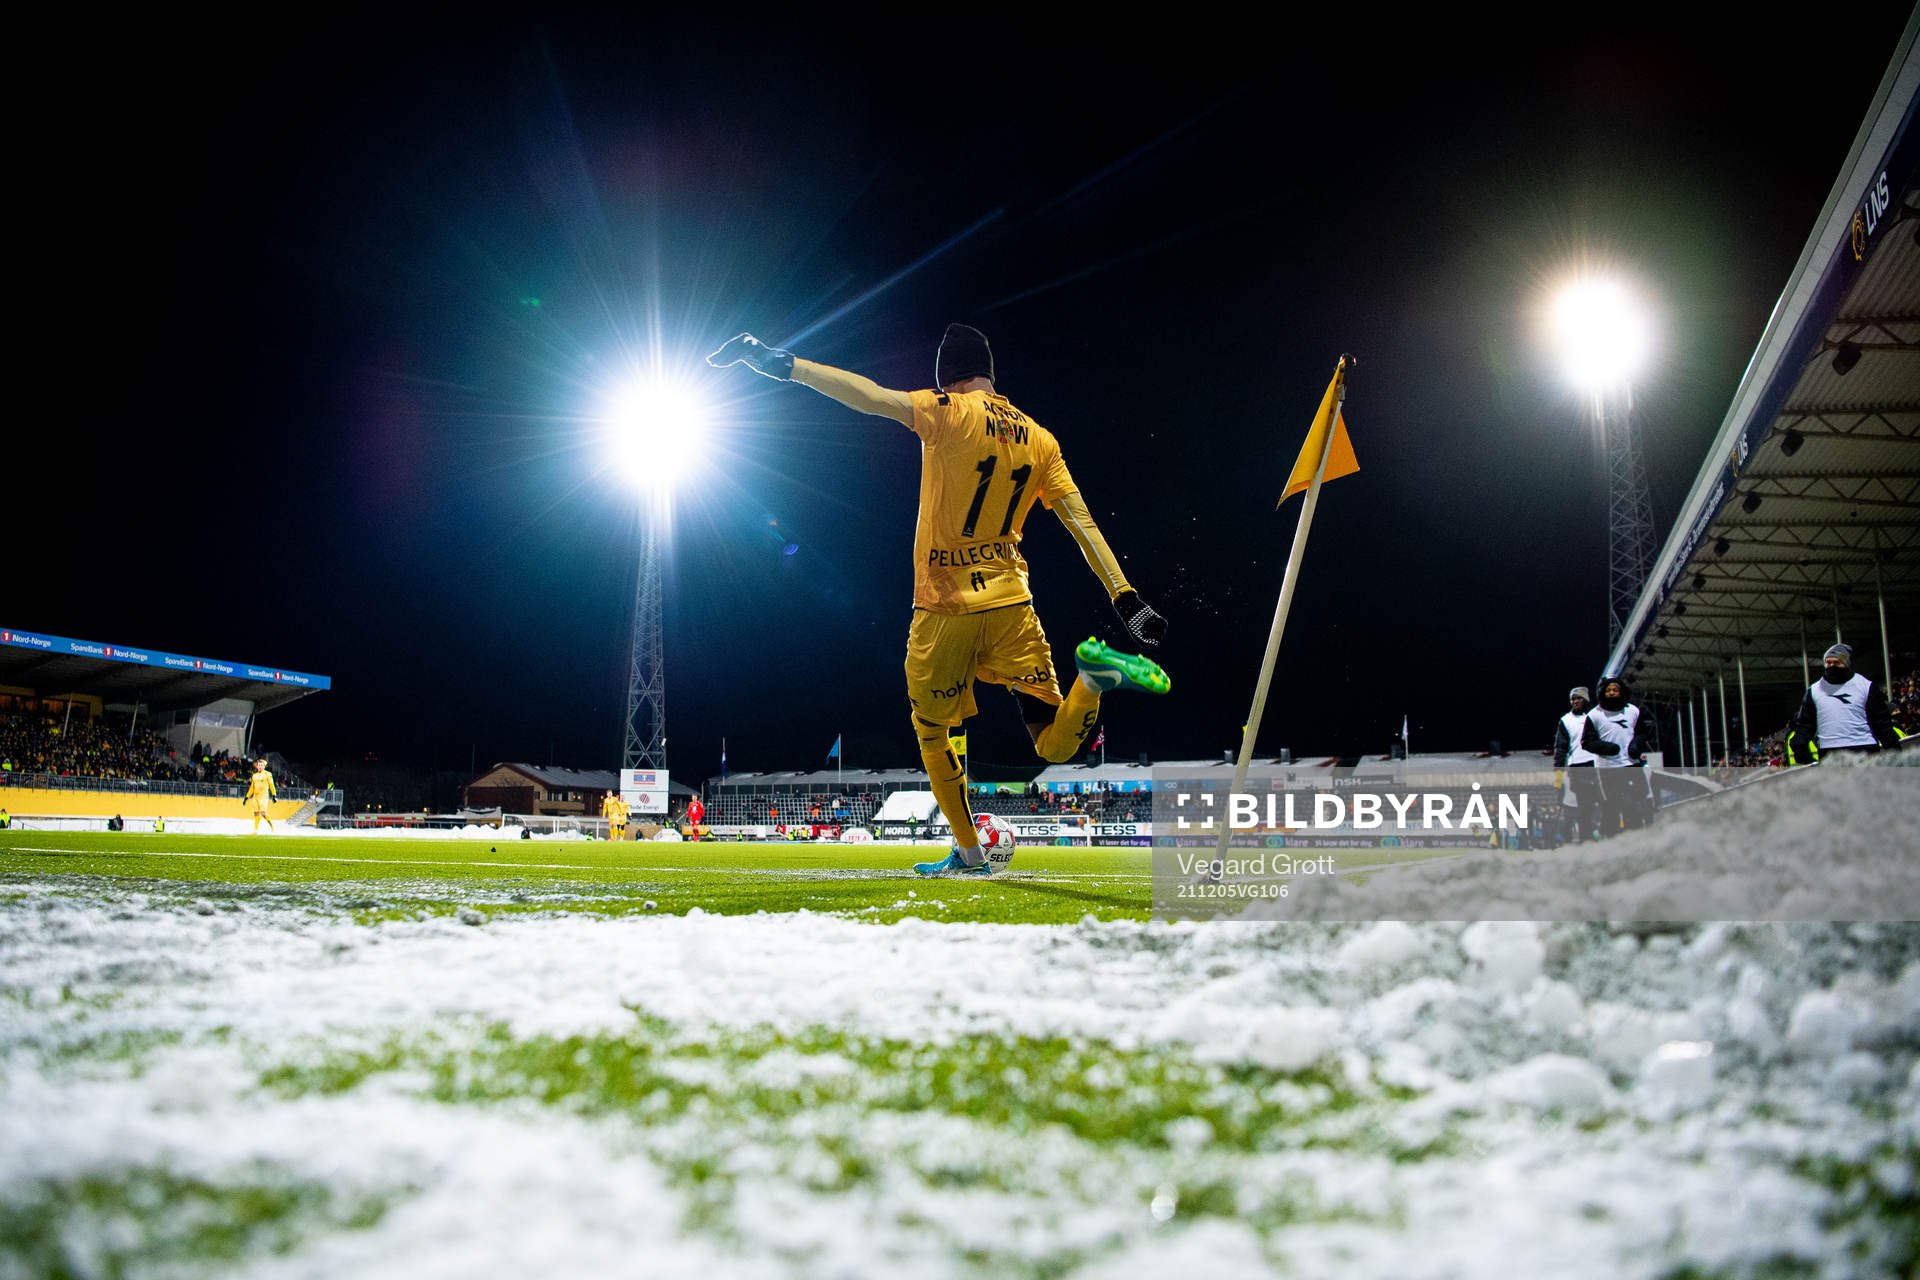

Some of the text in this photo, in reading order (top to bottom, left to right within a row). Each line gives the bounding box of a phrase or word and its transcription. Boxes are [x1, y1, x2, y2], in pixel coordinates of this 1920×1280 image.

[1864, 170, 1890, 237] LNS
[961, 455, 1033, 538] 11
[12, 634, 51, 648] Nord-Norge
[70, 642, 103, 655] SpareBank
[113, 649, 148, 662] Nord-Norge
[165, 656, 194, 668] SpareBank
[202, 662, 234, 674] Nord-Norge
[884, 826, 942, 835] NORDSFLT
[1016, 825, 1058, 836] TESS
[1091, 824, 1137, 836] TESS
